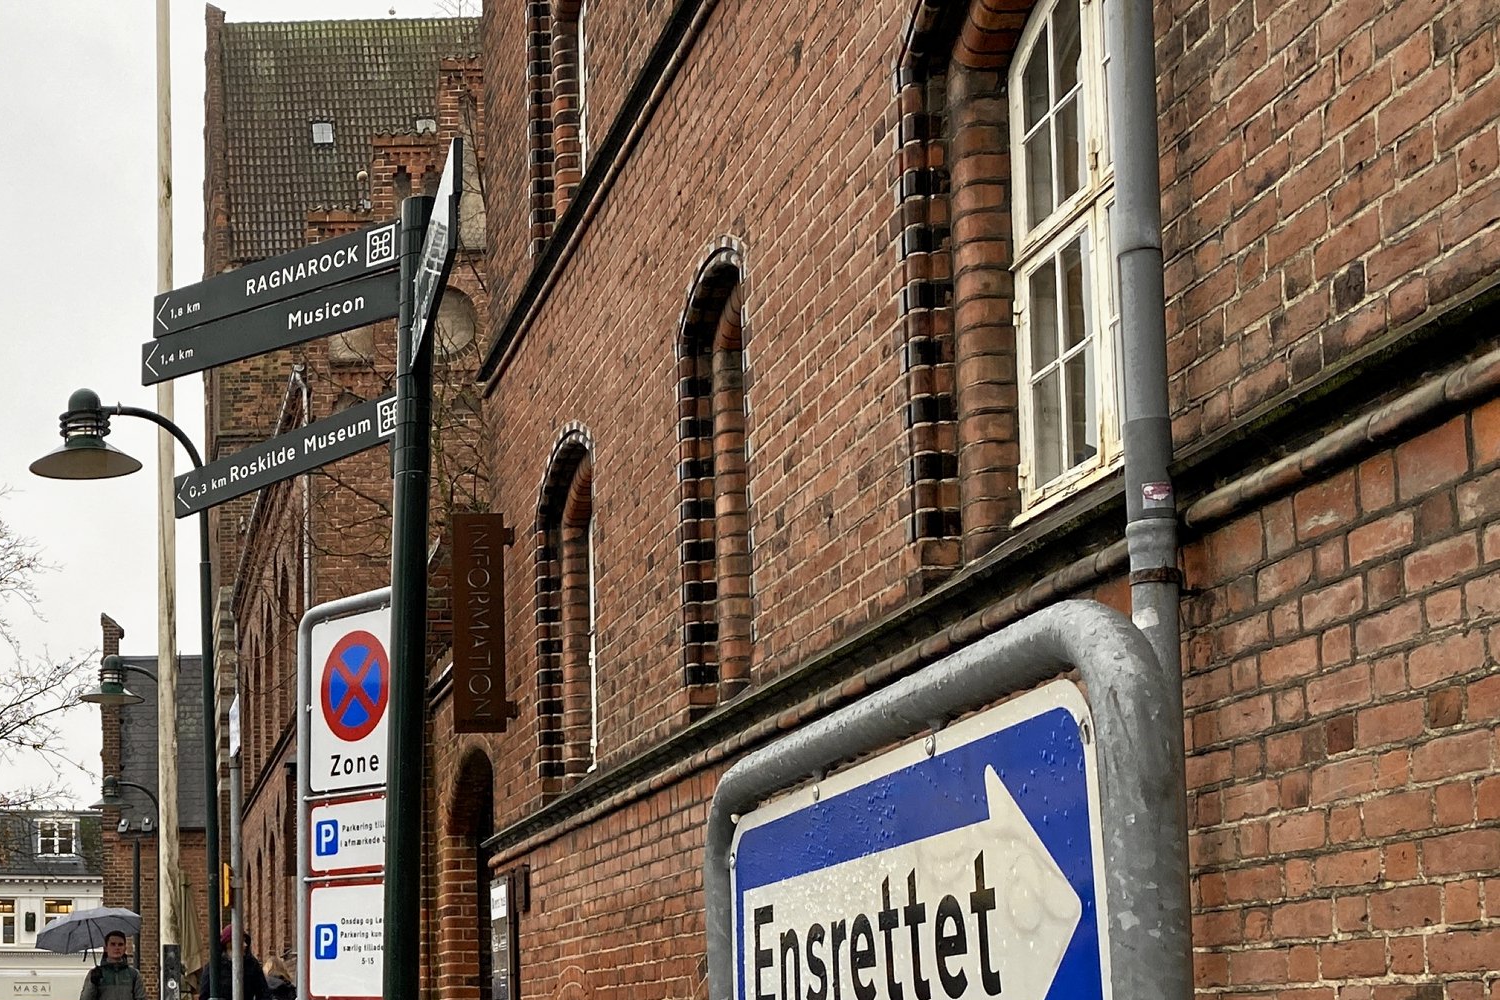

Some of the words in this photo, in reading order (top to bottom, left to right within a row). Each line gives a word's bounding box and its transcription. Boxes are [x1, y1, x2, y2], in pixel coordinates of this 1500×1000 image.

[169, 307, 183, 320] 1,8
[186, 301, 201, 314] km
[245, 245, 359, 297] RAGNAROCK
[160, 352, 174, 365] 1,4
[178, 347, 194, 360] km
[287, 295, 365, 330] Musicon
[189, 482, 207, 499] 0,3
[211, 476, 227, 490] km
[229, 446, 296, 483] Roskilde
[303, 417, 371, 455] Museum
[467, 524, 492, 717] INFORMATION
[330, 754, 380, 777] Zone
[341, 822, 373, 832] Parkering
[340, 917, 363, 925] Onsdag
[340, 931, 369, 939] Parkering
[343, 944, 362, 952] særlig
